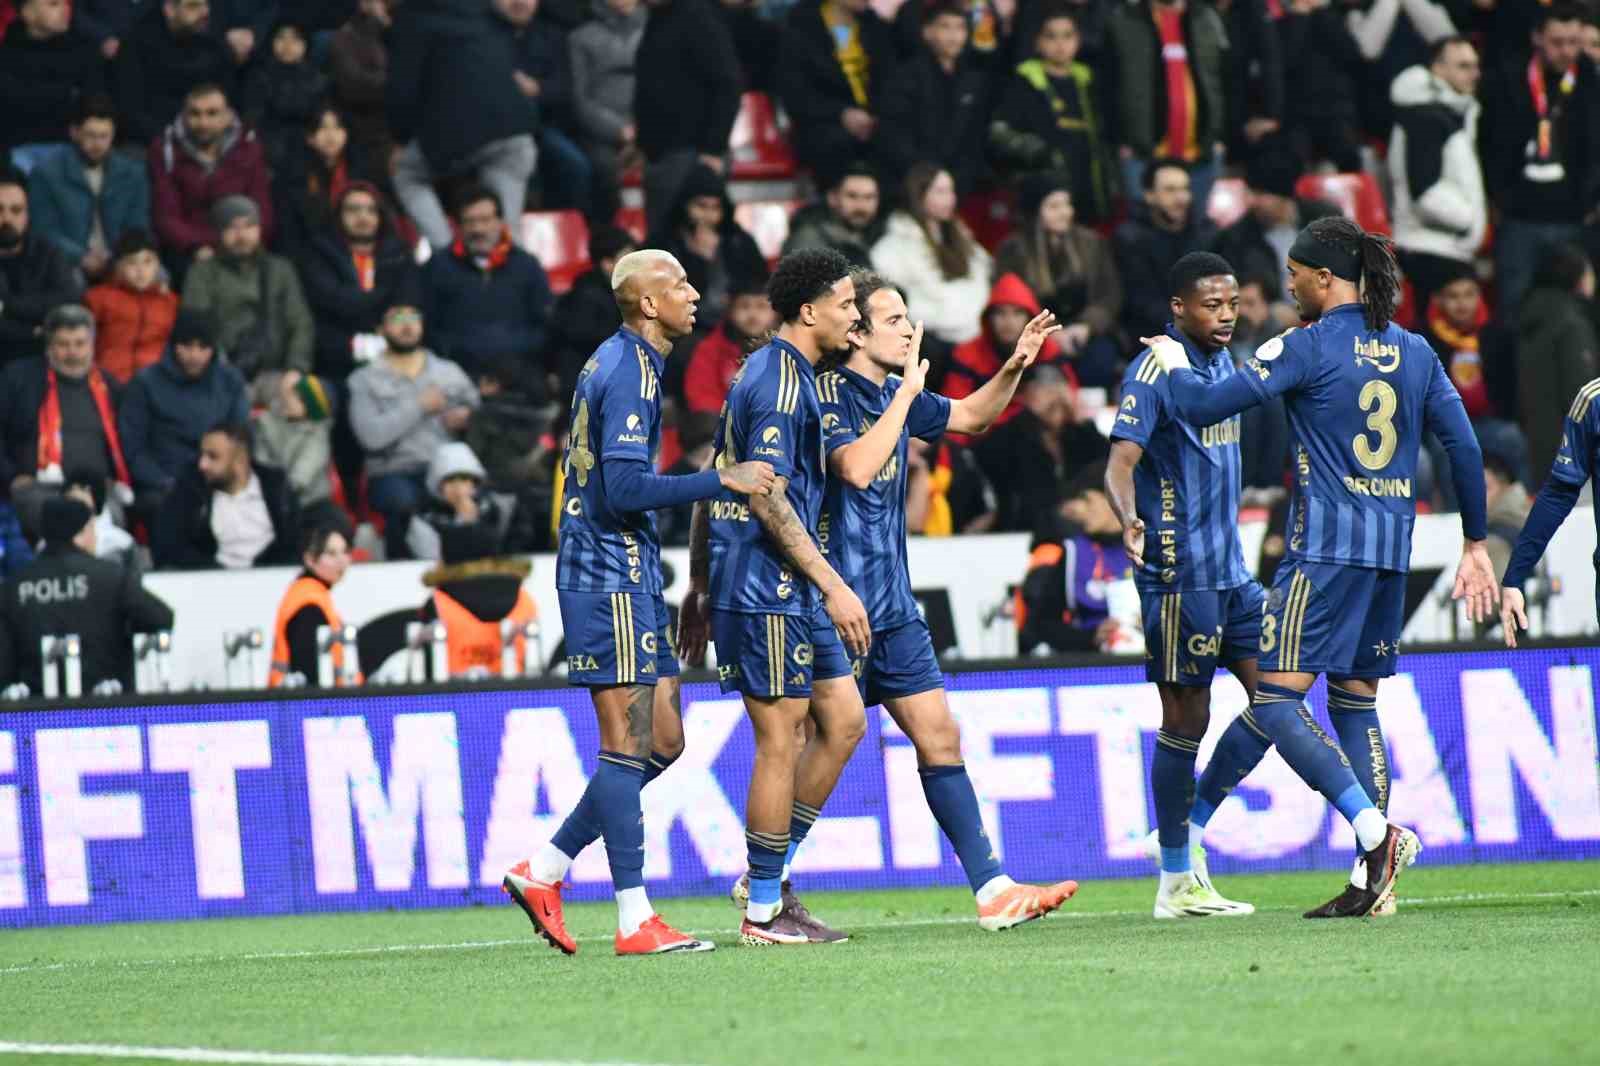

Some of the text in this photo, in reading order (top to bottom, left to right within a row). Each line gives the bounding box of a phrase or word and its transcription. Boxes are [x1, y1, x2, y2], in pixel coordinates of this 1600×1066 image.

[1352, 379, 1397, 471] 3
[1160, 477, 1176, 522] PORT
[1342, 475, 1411, 498] BROWN
[1259, 613, 1277, 653] 3
